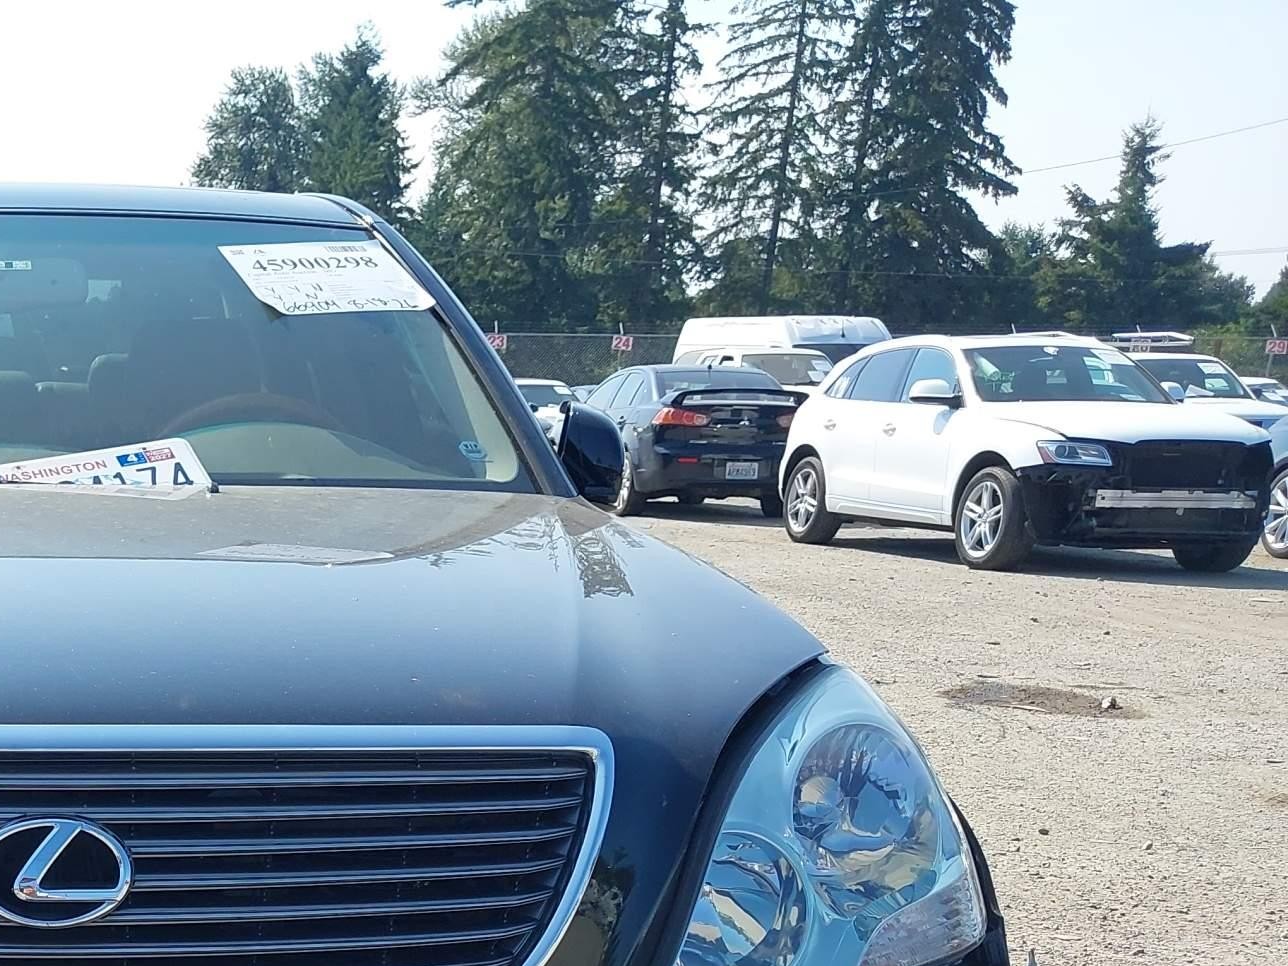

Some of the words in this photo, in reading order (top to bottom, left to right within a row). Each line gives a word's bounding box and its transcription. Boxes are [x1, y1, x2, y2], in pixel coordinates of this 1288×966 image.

[252, 256, 379, 271] 45900298
[488, 335, 505, 348] 23
[614, 336, 631, 350] 24
[1268, 341, 1286, 353] 29
